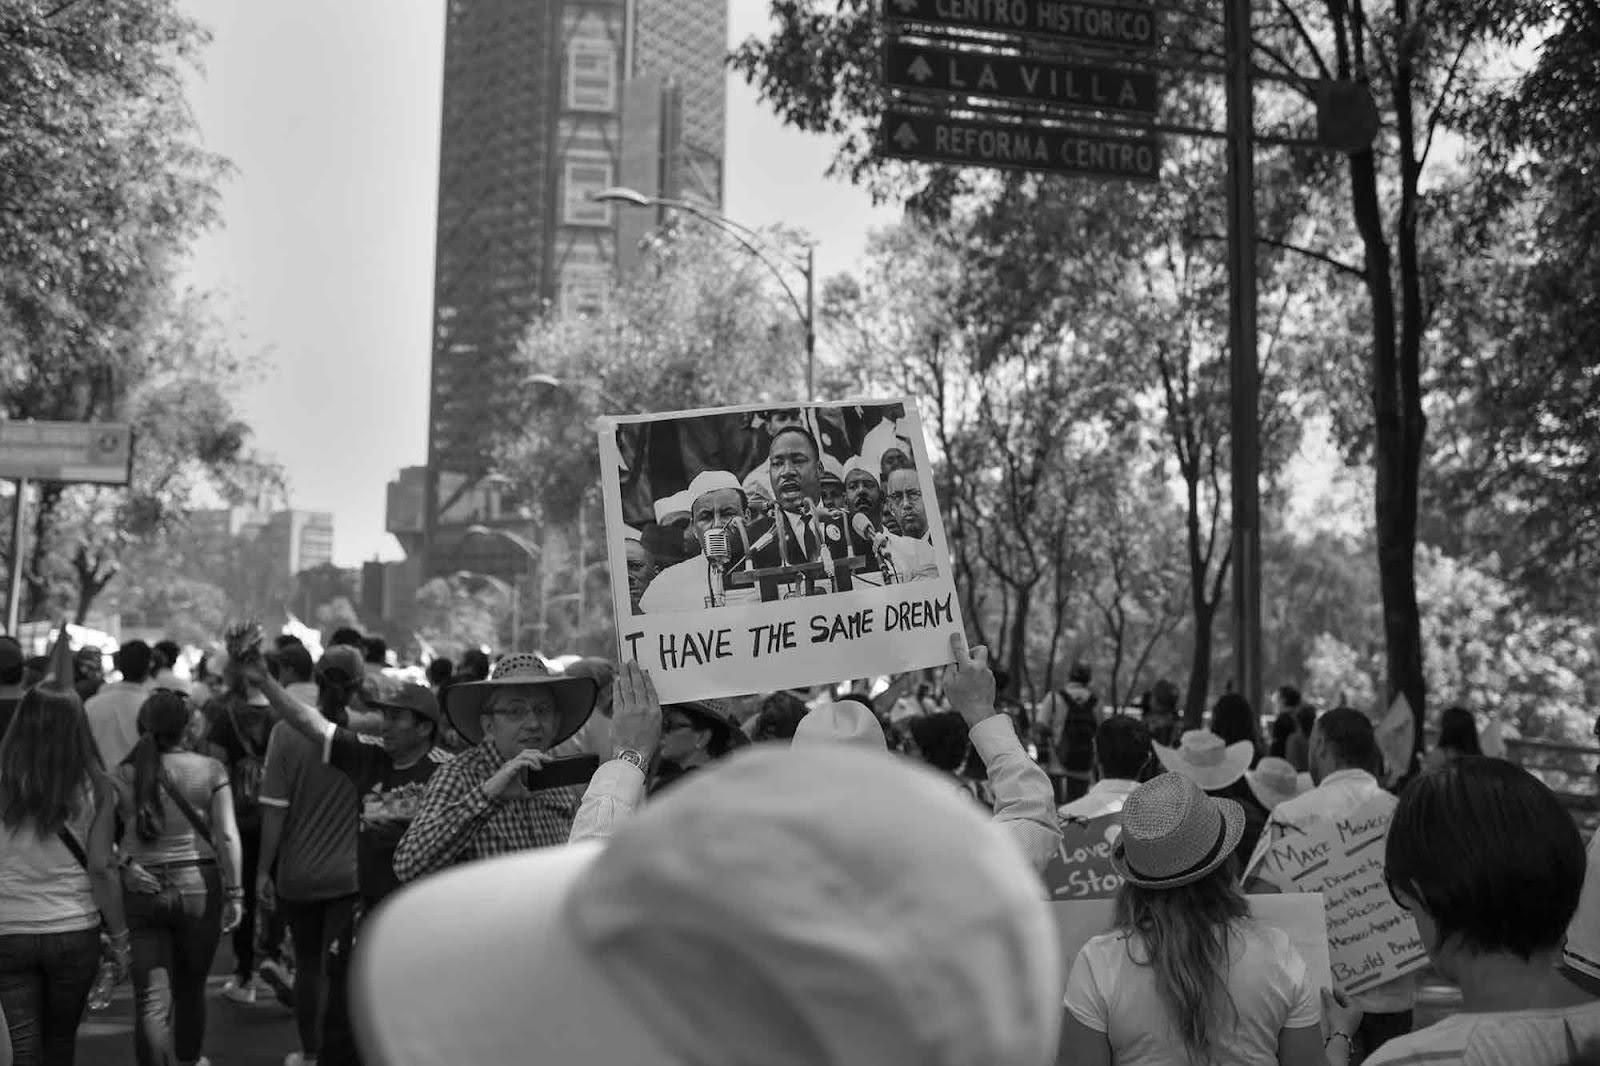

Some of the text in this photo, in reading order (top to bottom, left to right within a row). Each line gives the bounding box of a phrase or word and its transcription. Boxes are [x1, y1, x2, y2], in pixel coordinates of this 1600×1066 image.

[935, 0, 1150, 41] CENTRO HISTORICO
[1020, 65, 1137, 105] VILLA
[935, 124, 1151, 172] REFORMA CENTRO
[659, 628, 733, 671] HAVE
[748, 621, 798, 657] THE
[810, 608, 874, 644] SAME
[884, 592, 954, 633] DREAM
[1330, 951, 1385, 982] Build
